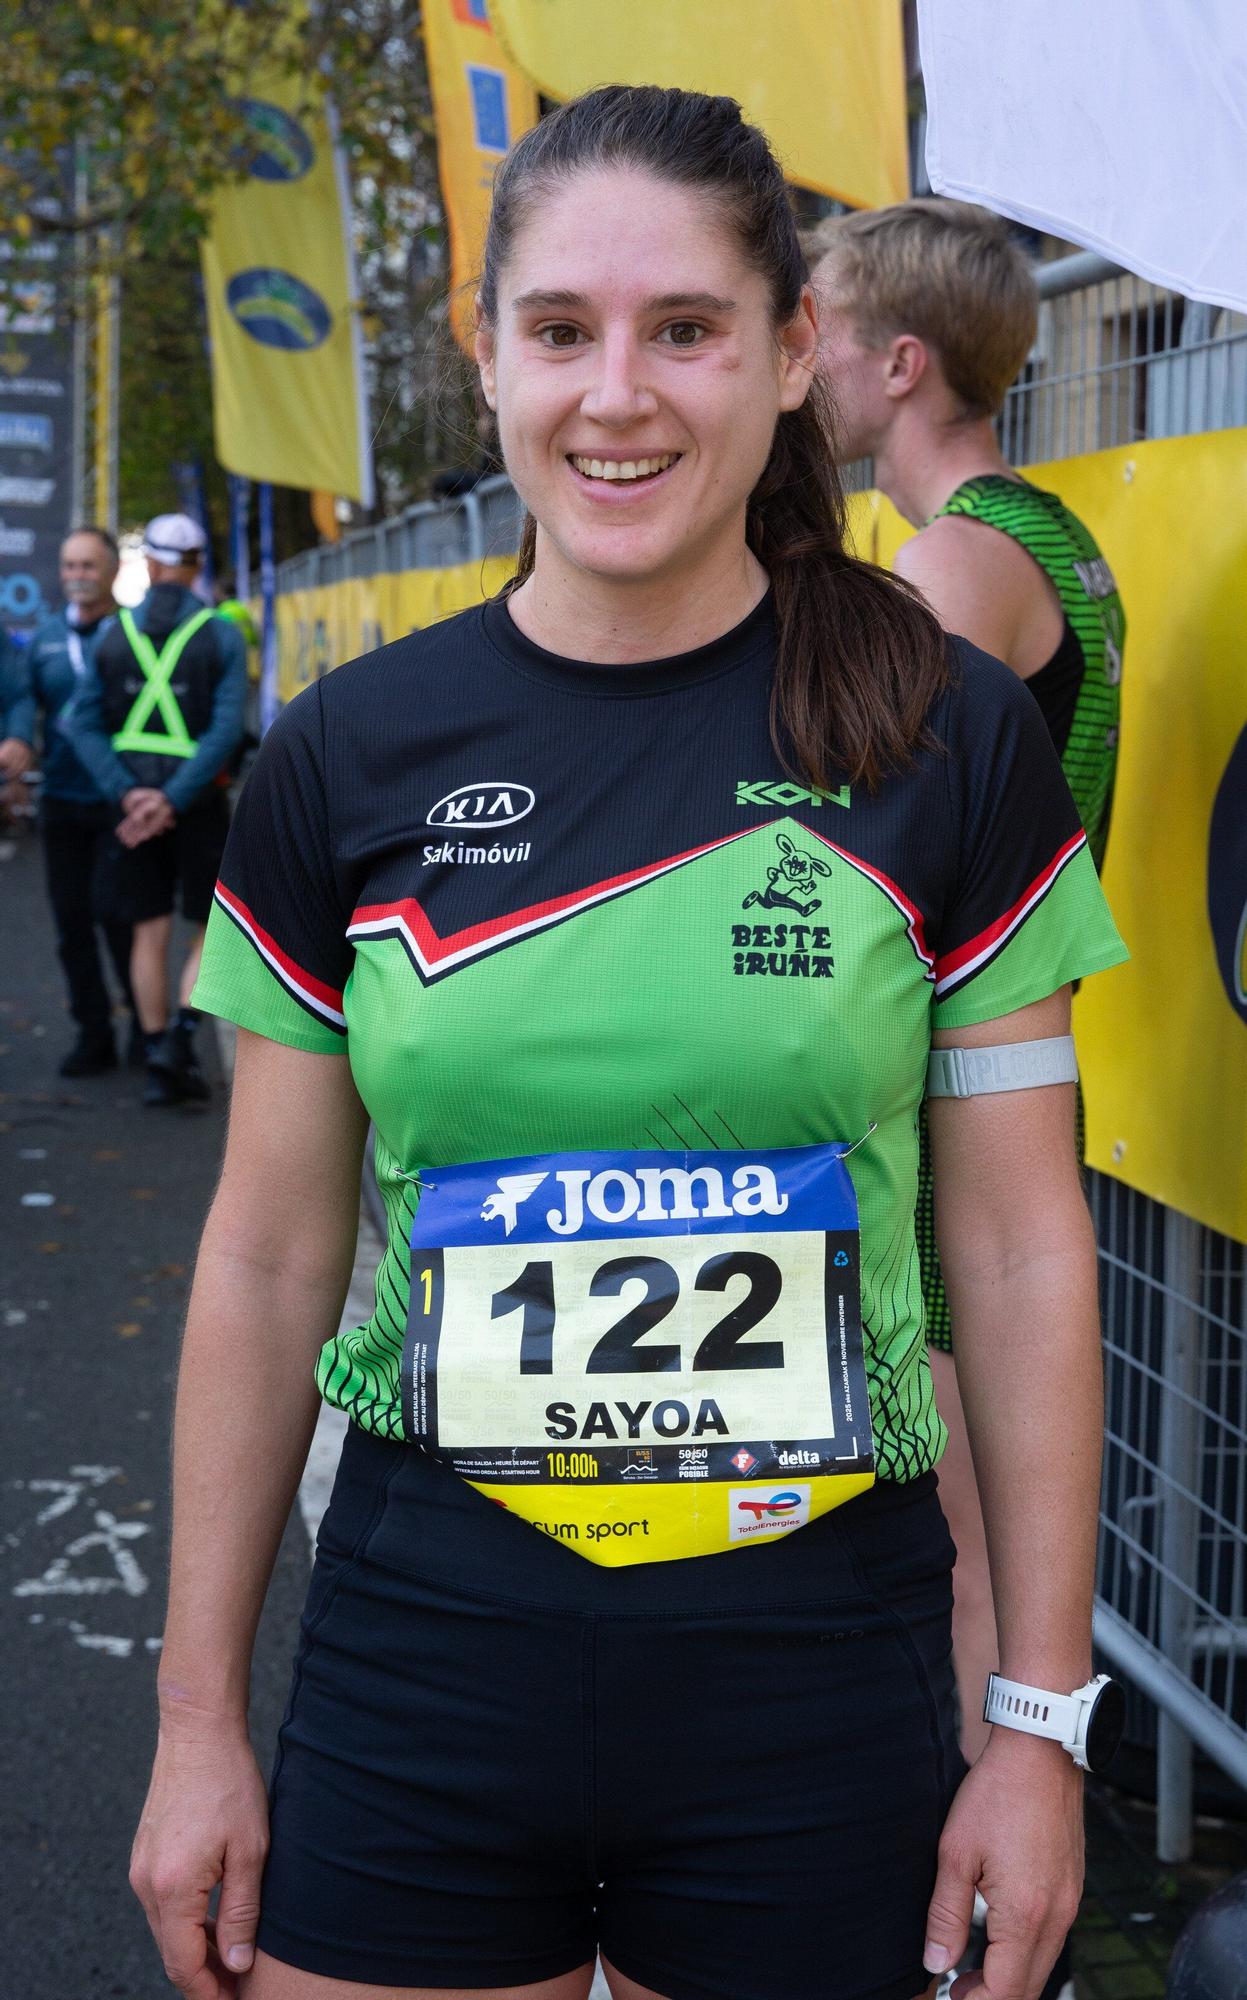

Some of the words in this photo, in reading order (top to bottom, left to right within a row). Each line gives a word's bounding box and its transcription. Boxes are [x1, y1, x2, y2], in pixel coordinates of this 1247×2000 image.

[443, 791, 515, 823] KIA
[421, 841, 532, 866] Sakimóvil
[731, 923, 833, 950] BESTE
[490, 1251, 785, 1376] 122
[420, 1358, 426, 1366] AT
[421, 1406, 427, 1414] AU
[544, 1398, 730, 1440] SAYOA
[546, 1453, 598, 1478] 10:00h
[778, 1450, 820, 1466] delta
[678, 1470, 708, 1478] POSIBLE
[585, 1519, 649, 1542] sport
[737, 1518, 801, 1534] TotalEnergies
